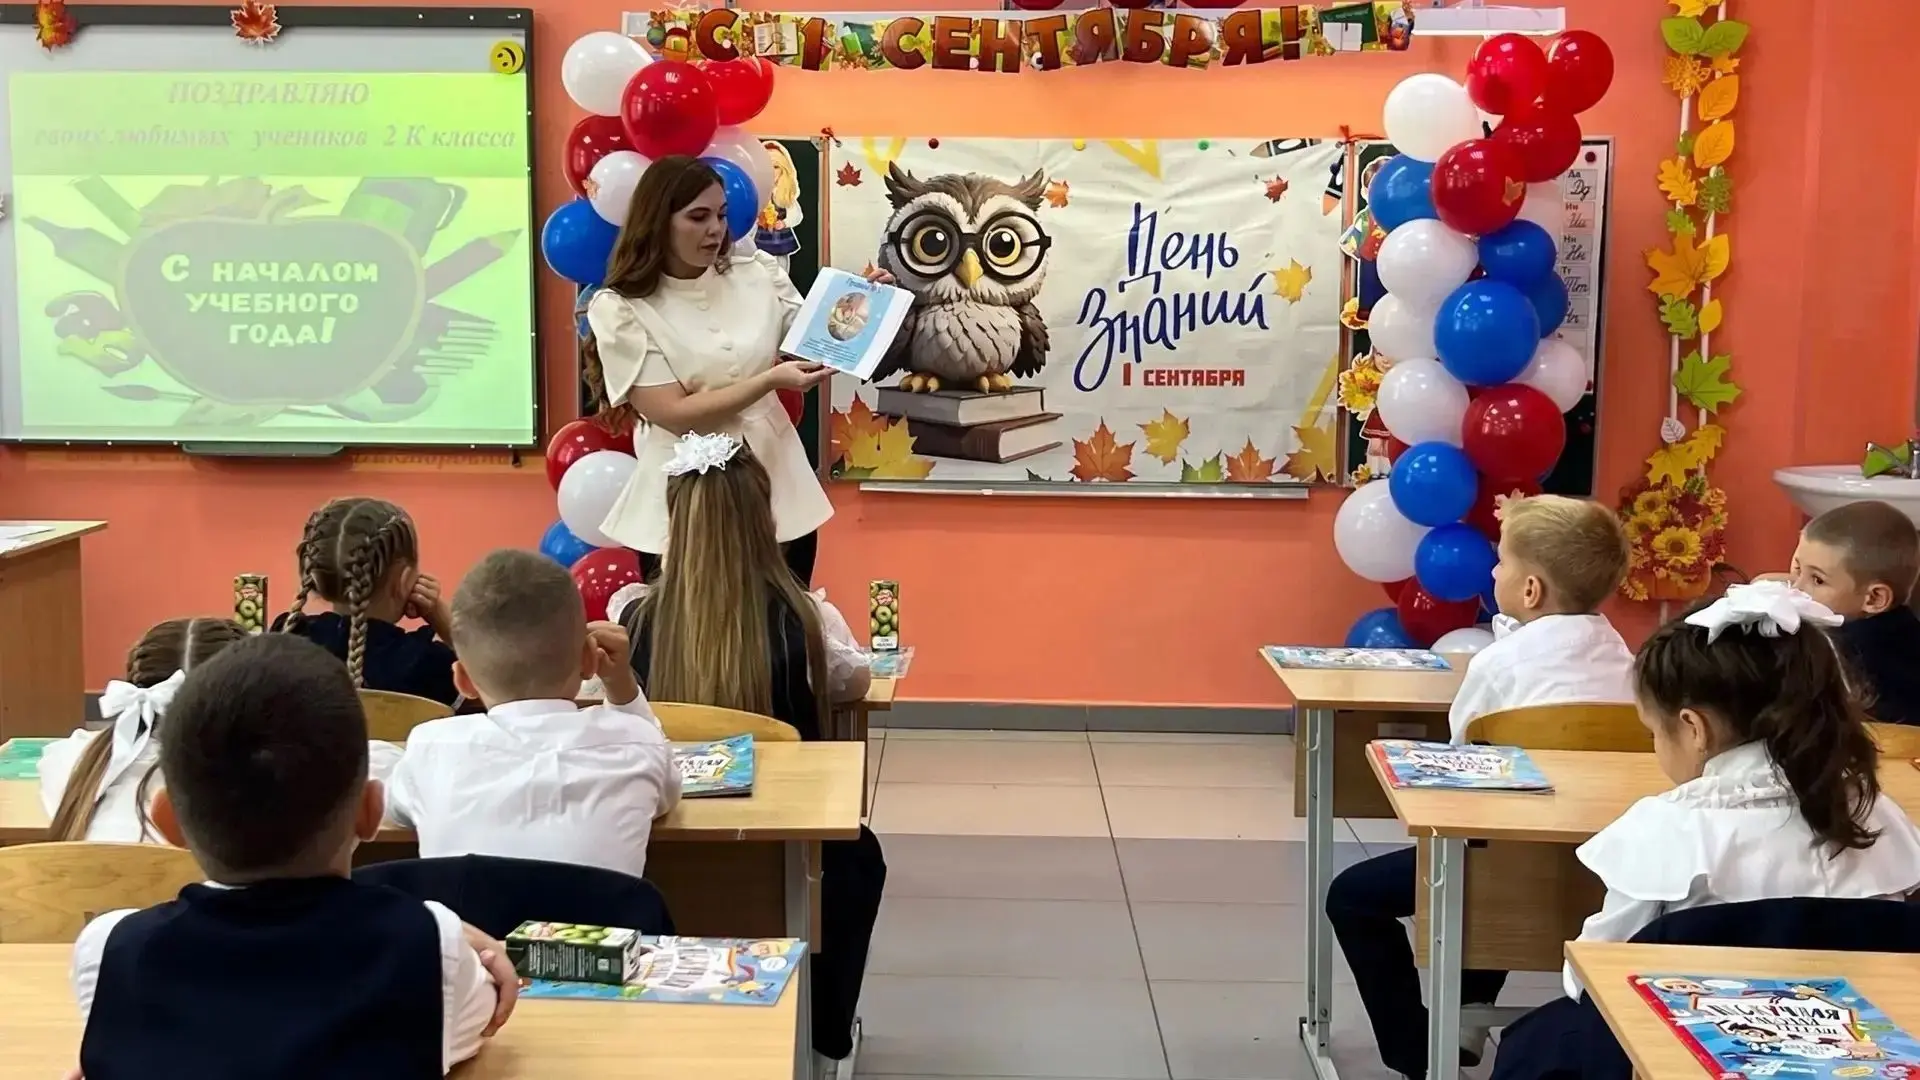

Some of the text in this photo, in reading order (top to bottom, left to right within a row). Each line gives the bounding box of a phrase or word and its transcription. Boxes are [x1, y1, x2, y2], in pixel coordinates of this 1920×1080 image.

[698, 8, 741, 62] С
[800, 17, 828, 72] 1
[167, 81, 370, 107] ПОЗДРАВЛЯЮ
[107, 123, 232, 148] любимых
[252, 128, 369, 151] учеников
[383, 124, 398, 147] 2
[405, 124, 427, 148] К
[431, 128, 516, 148] класса
[1118, 201, 1240, 295] День
[161, 253, 379, 283] С НАЧАЛОМ
[185, 292, 360, 313] УЧЕБНОГО
[228, 316, 337, 348] ГОДА!
[1073, 272, 1270, 392] Знаний
[1143, 369, 1246, 387] СЕНТЯБРЯ
